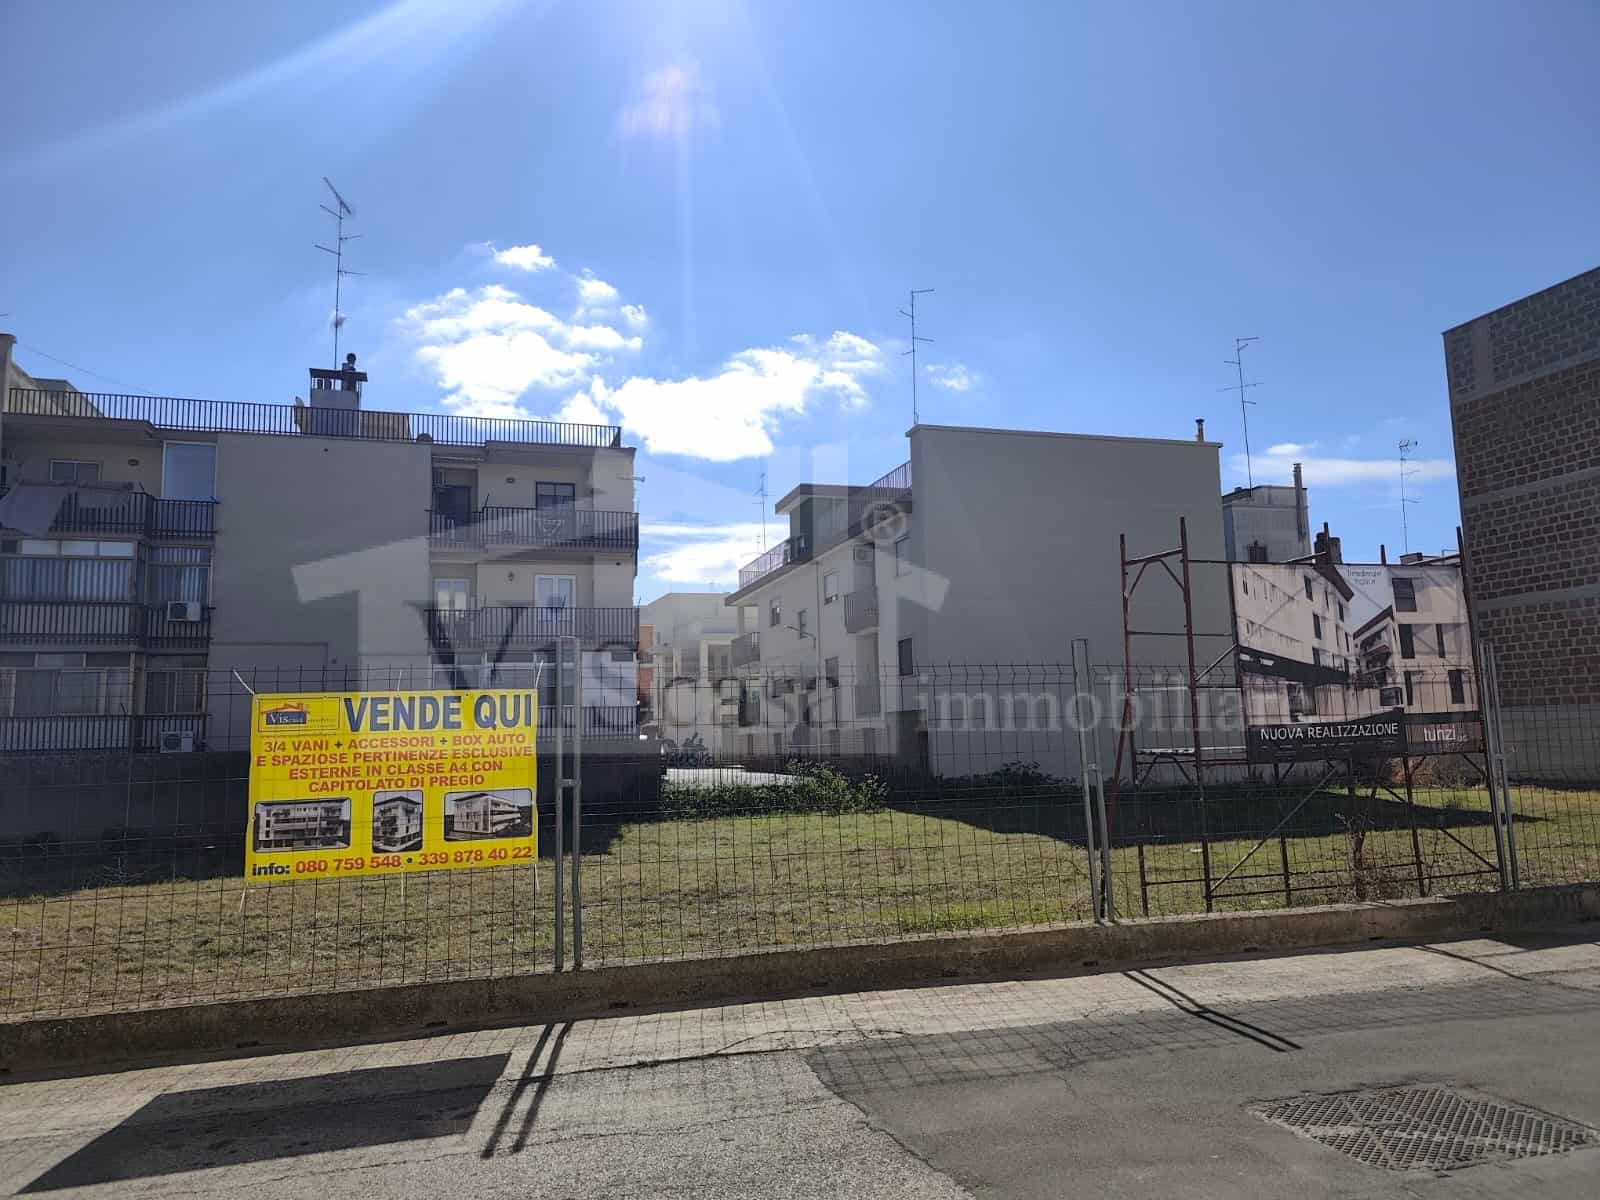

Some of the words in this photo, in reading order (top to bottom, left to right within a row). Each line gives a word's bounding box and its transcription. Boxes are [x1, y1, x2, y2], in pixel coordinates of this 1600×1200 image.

[343, 695, 462, 732] VENDE
[474, 694, 532, 731] QUI
[1260, 727, 1304, 740] NUOVA
[1308, 722, 1399, 739] REALIZZAZIONE
[264, 741, 286, 753] 3/4
[291, 740, 329, 752] VANI
[347, 736, 434, 750] ACCESSORI
[452, 735, 482, 746] BOX
[487, 733, 526, 745] AUTO
[256, 755, 267, 767] E
[271, 752, 348, 767] SPAZIOSE
[353, 749, 448, 764] PERTINENZE
[451, 745, 533, 760] ESCLUSIVE
[289, 766, 361, 780] ESTERNE
[366, 765, 382, 777] IN
[386, 761, 445, 776] CLASSE
[449, 760, 469, 774] A4
[471, 760, 503, 773] CON
[308, 777, 406, 793] CAPITOLATO
[410, 777, 425, 788] DI
[429, 774, 485, 787] PREGIO
[252, 863, 291, 876] info:
[295, 860, 328, 873] 080
[334, 857, 365, 871] 759
[369, 855, 401, 868] 548
[419, 852, 449, 865] 339
[454, 849, 483, 863] 878
[488, 847, 508, 860] 40
[512, 846, 533, 859] 22
